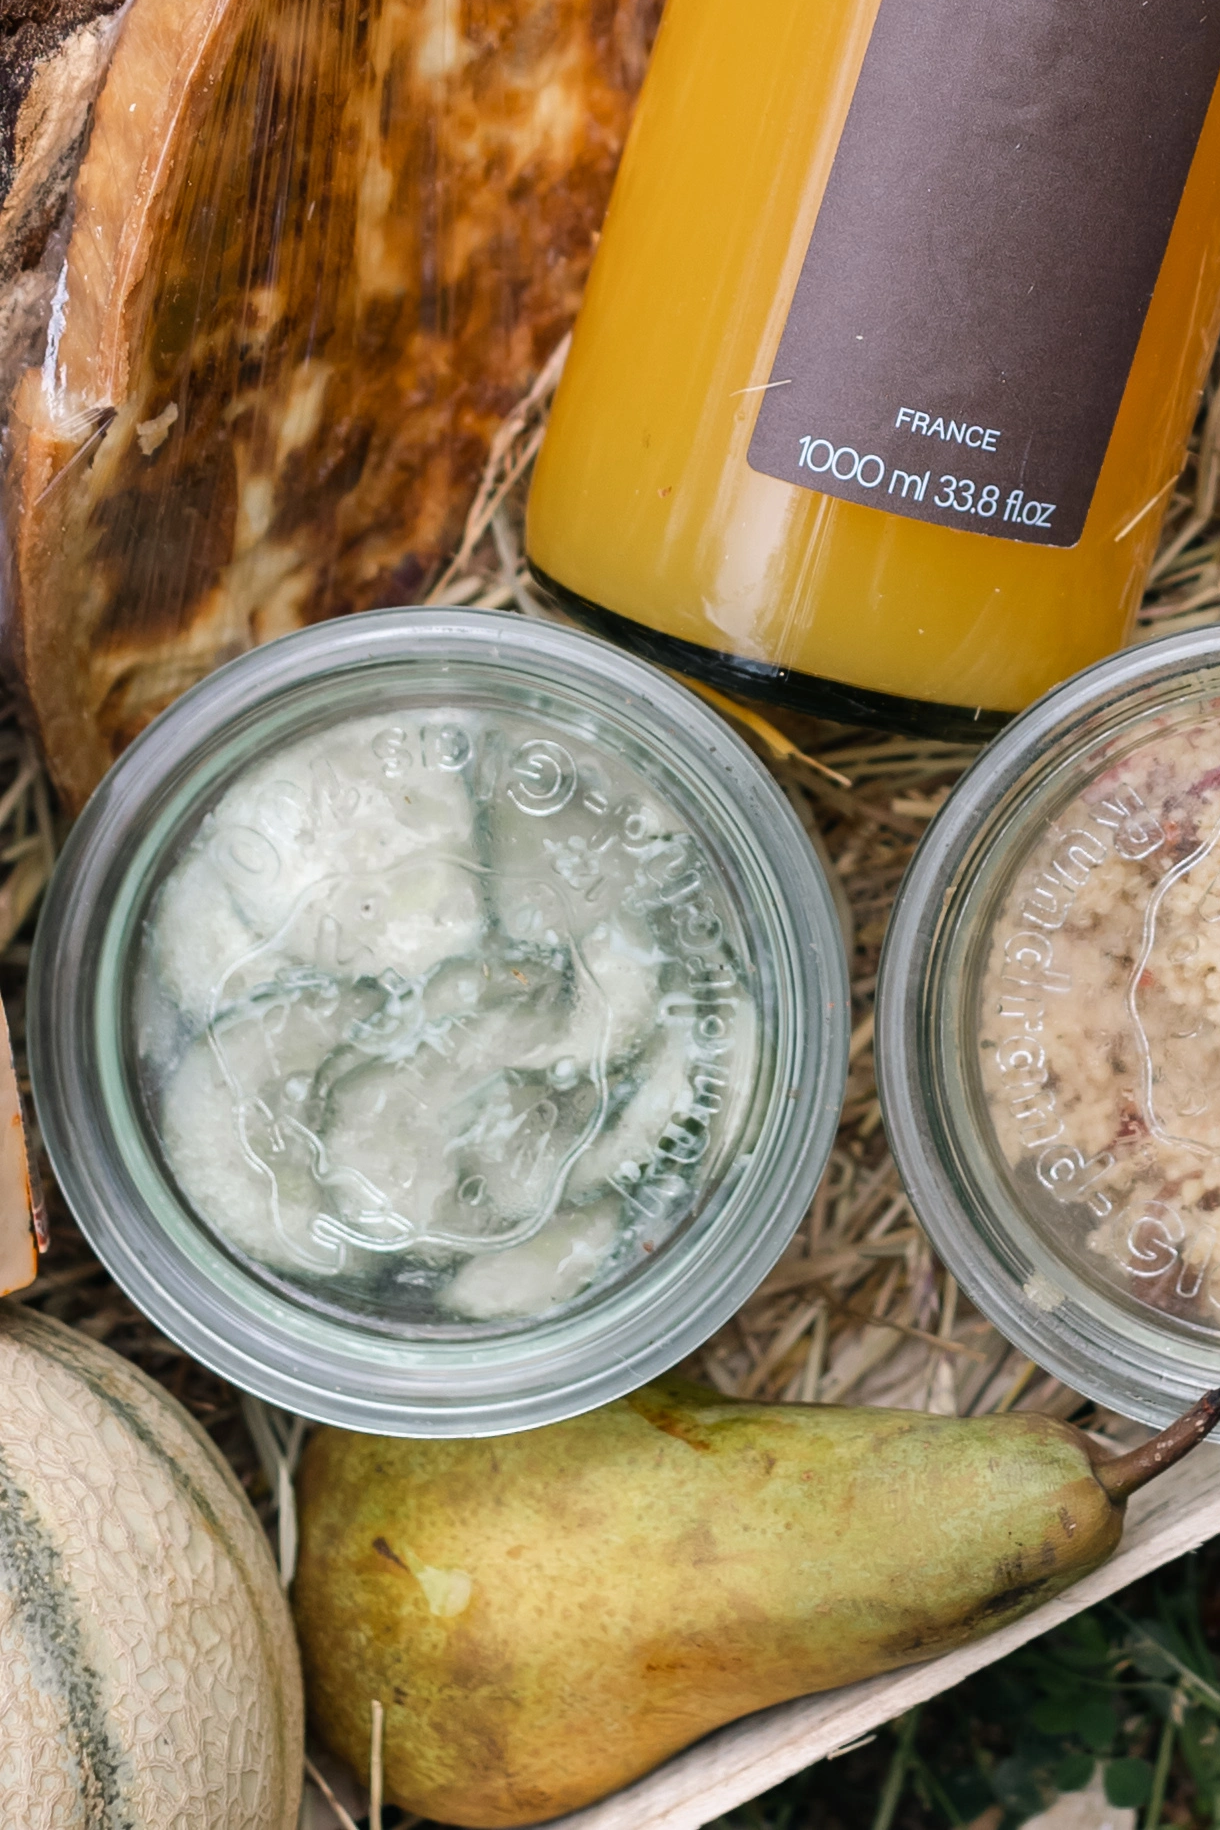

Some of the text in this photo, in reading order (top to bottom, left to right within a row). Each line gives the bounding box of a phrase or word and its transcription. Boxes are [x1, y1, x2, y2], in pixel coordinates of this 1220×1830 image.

[895, 406, 1001, 453] FRANCE
[798, 434, 886, 489] 1000
[888, 469, 931, 503] ml
[933, 474, 1001, 518] 33.8
